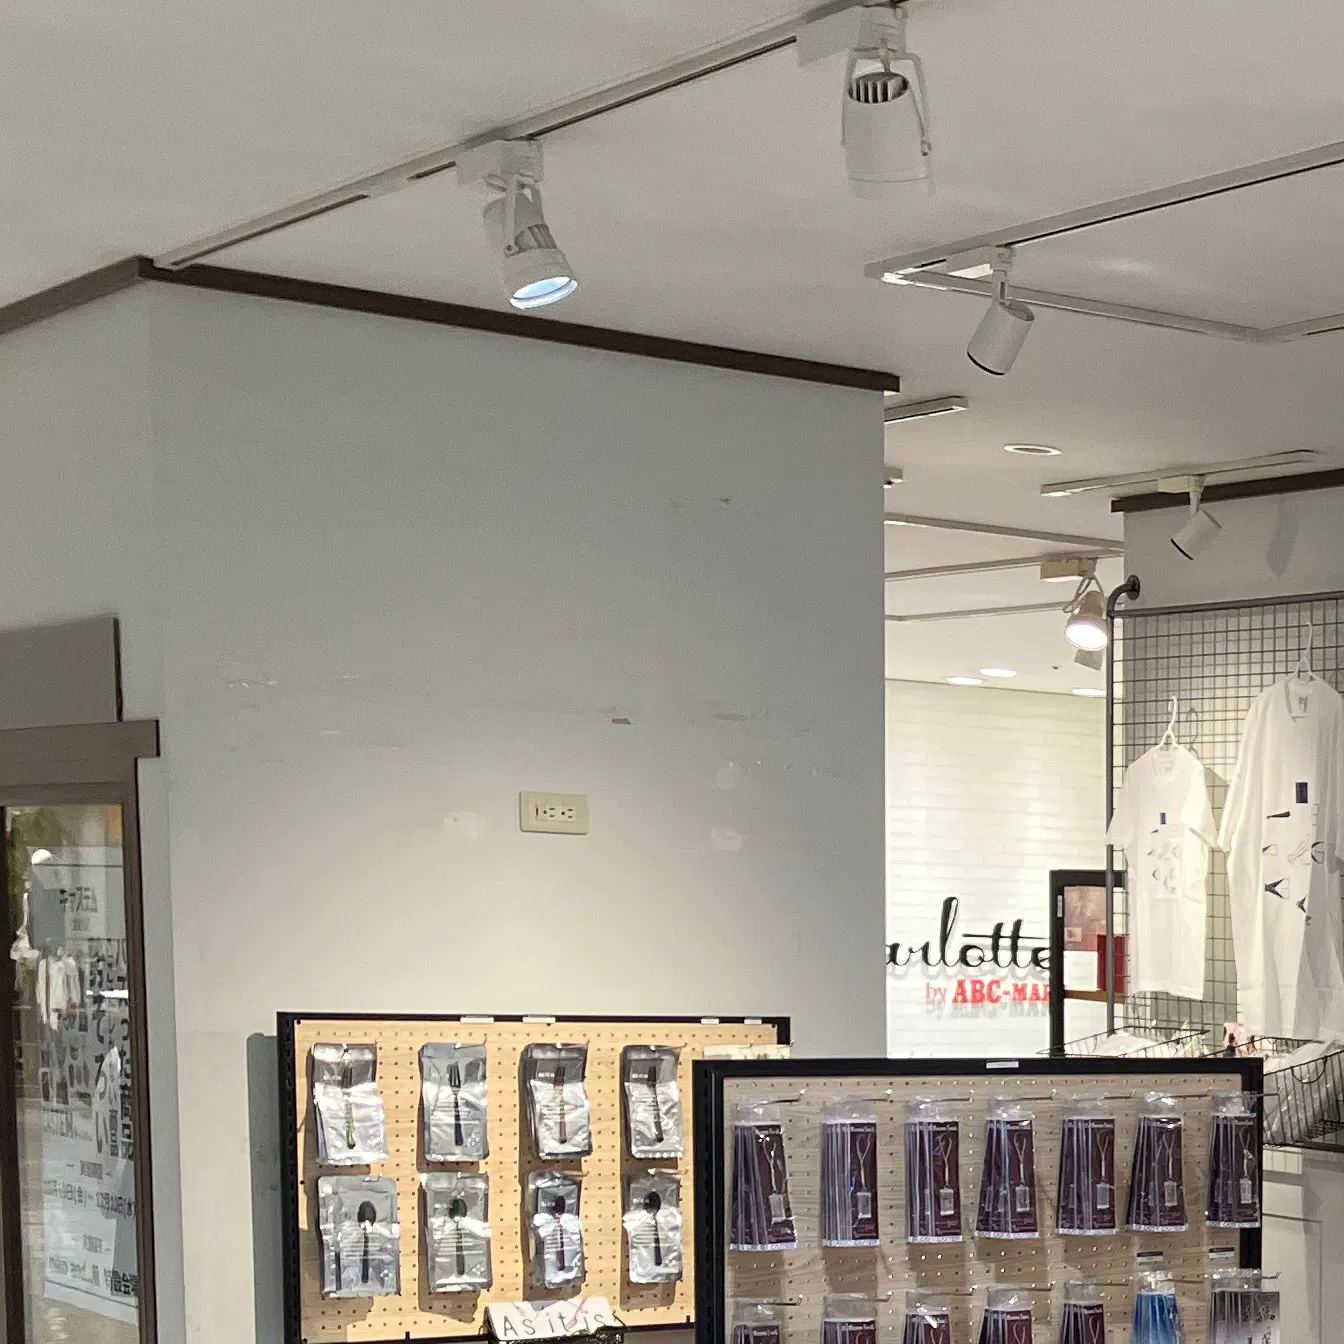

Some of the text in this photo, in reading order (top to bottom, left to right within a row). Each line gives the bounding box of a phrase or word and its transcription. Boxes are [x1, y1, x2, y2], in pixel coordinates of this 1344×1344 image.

[926, 982, 947, 1003] by
[503, 1309, 606, 1337] As it is
